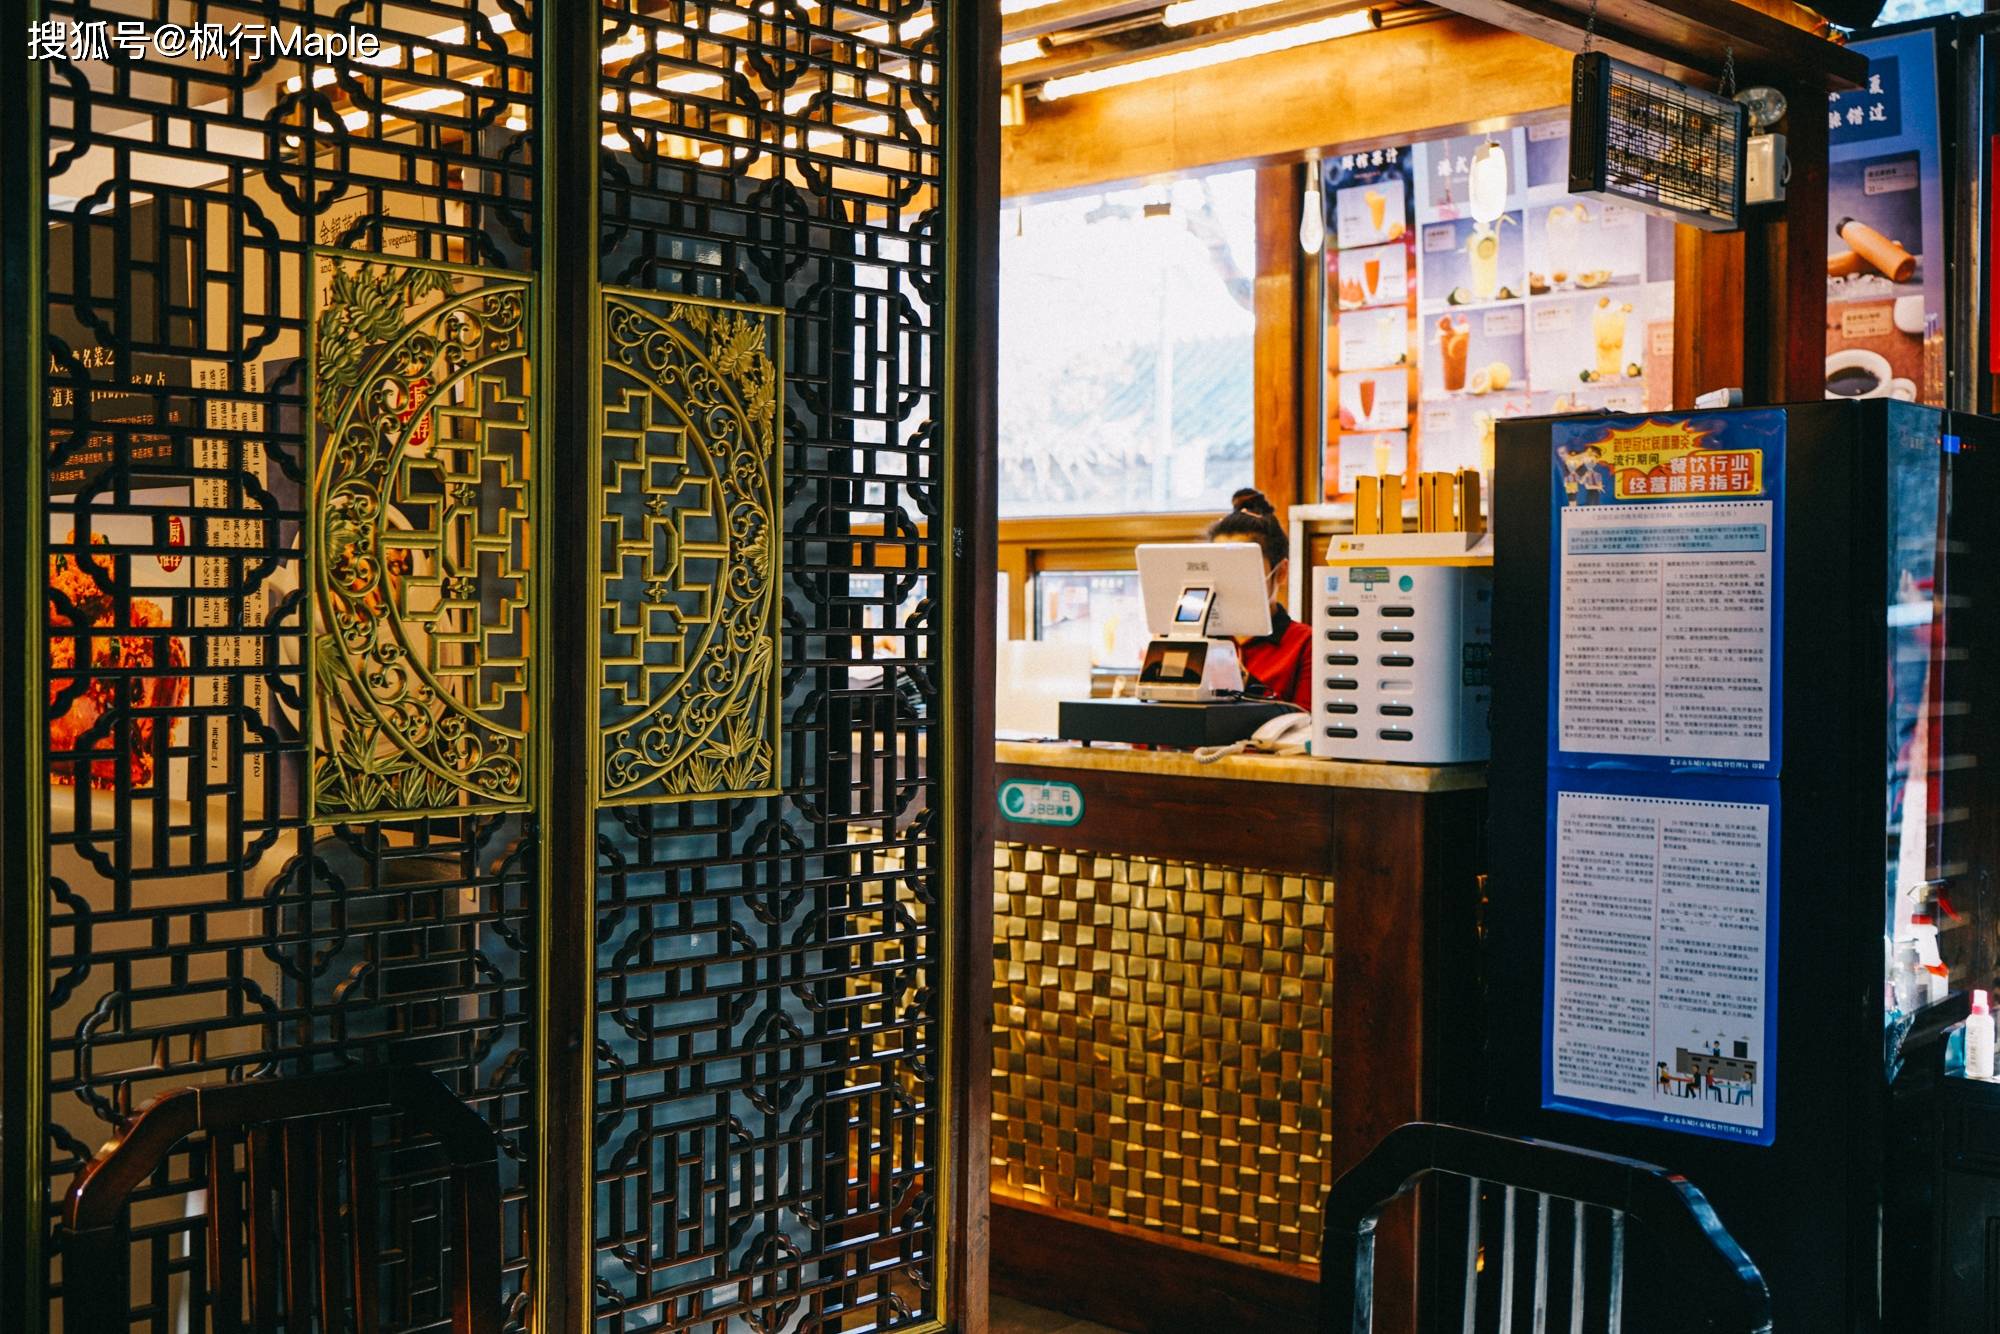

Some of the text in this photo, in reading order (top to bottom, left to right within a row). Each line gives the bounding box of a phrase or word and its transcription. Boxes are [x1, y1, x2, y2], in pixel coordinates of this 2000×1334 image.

[1613, 453, 1660, 466] 流行期间
[1670, 455, 1749, 474] 餐饮行业
[1629, 473, 1749, 494] 经营服务指引
